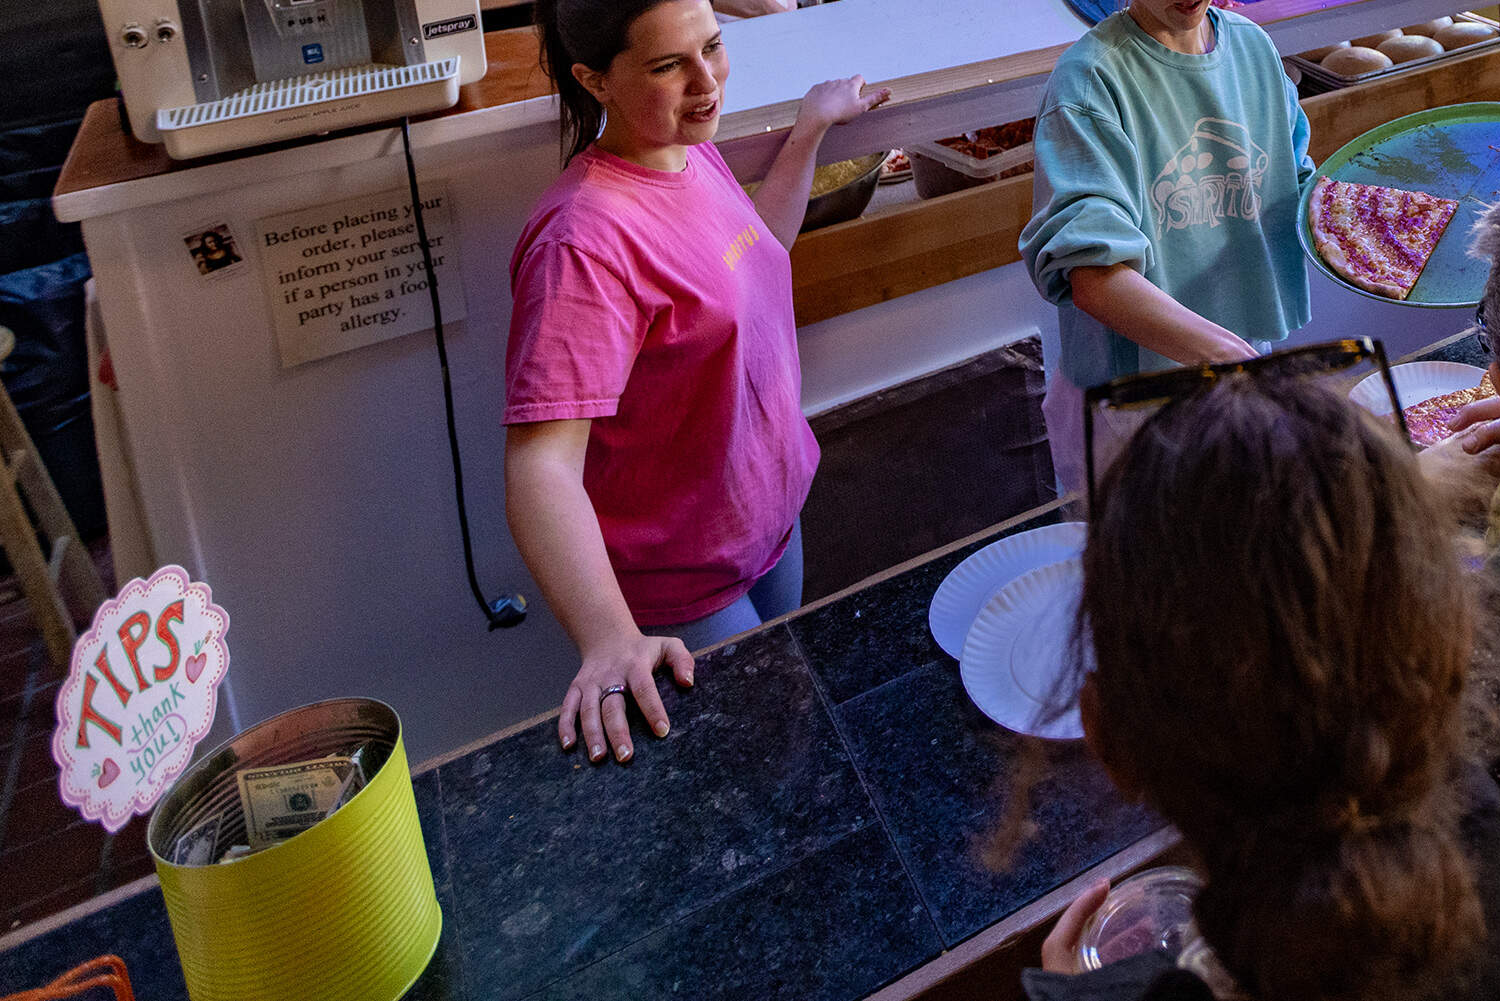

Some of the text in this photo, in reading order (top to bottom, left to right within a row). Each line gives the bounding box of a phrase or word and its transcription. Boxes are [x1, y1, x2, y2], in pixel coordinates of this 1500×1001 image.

[428, 20, 471, 37] jetspray
[264, 225, 328, 247] Before
[333, 208, 398, 234] placing
[361, 223, 414, 248] please
[279, 262, 340, 284] inform
[346, 249, 386, 272] your
[284, 287, 300, 305] if
[304, 288, 315, 300] a
[319, 272, 379, 299] person
[384, 265, 401, 280] in
[299, 279, 439, 326] party has a foo
[341, 306, 406, 332] allergy.
[76, 599, 184, 749] TIPS
[131, 681, 185, 746] thank
